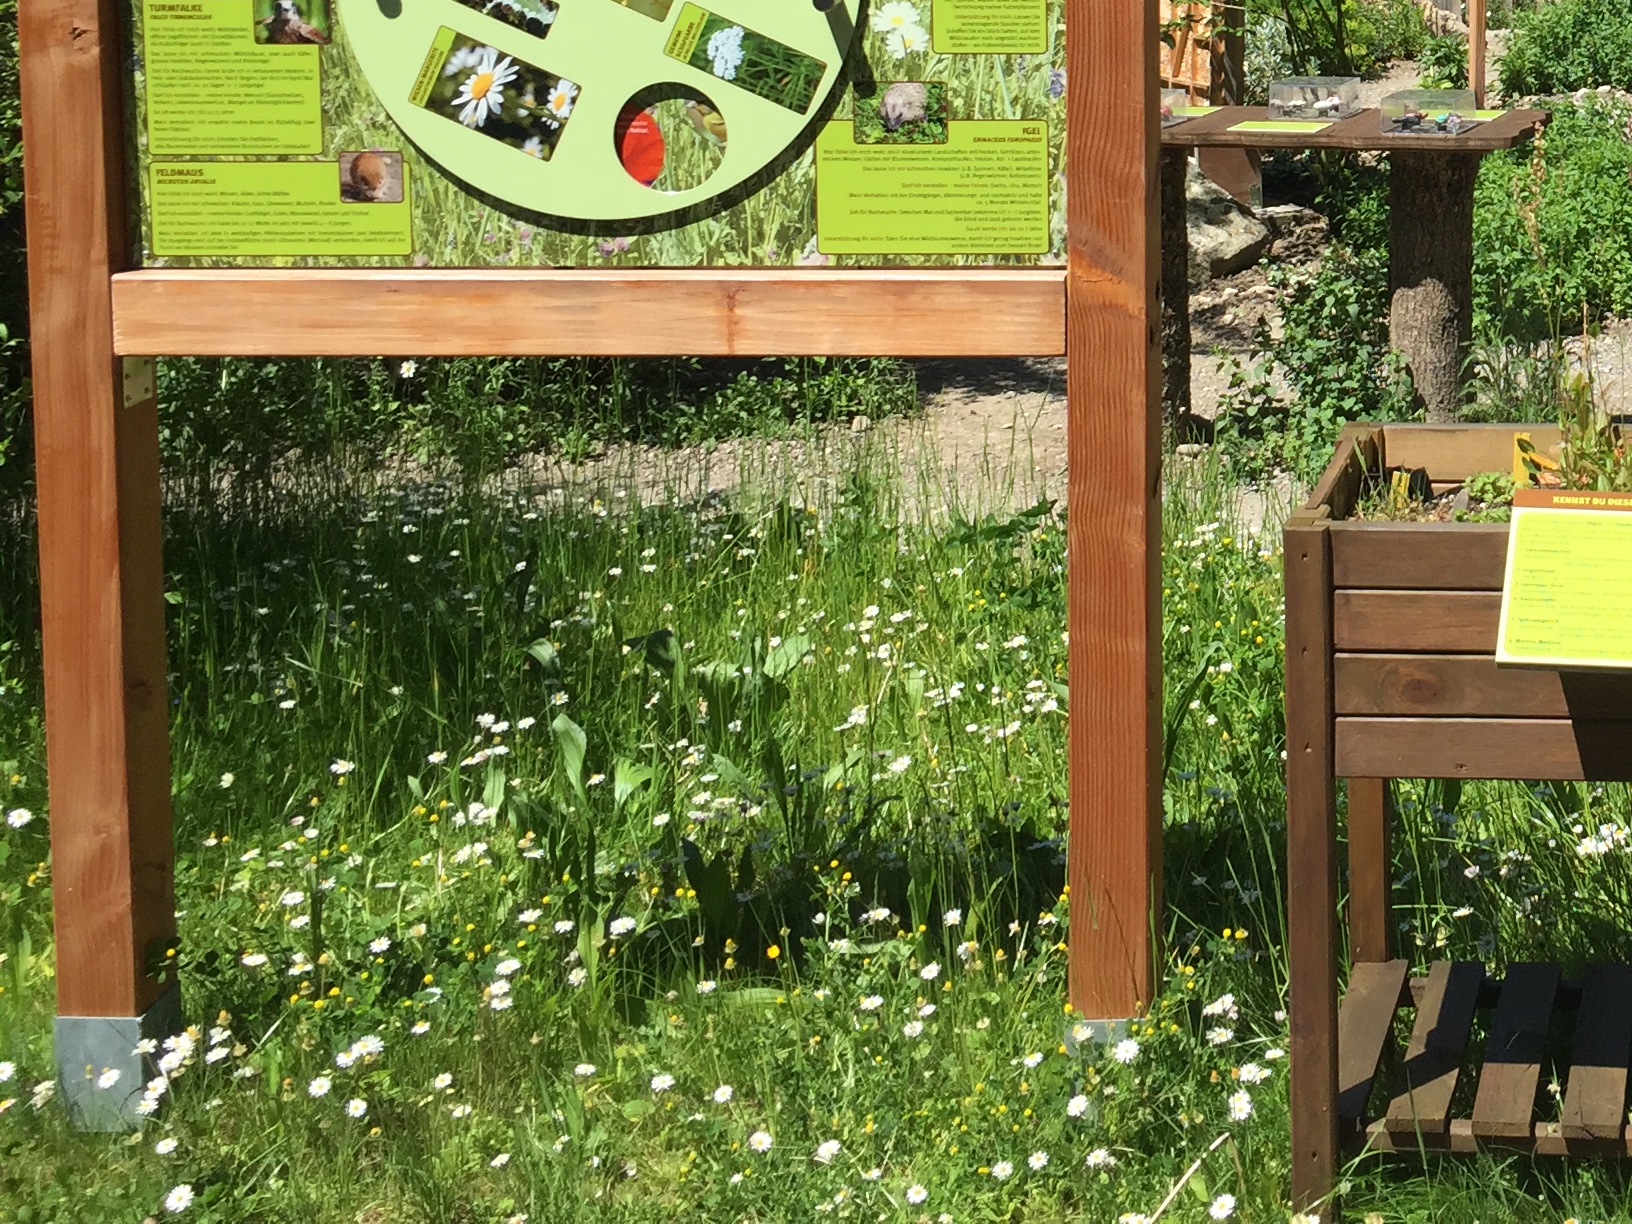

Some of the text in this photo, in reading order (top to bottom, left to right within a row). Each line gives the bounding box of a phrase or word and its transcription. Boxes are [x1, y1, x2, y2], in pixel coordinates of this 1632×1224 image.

[149, 4, 203, 13] TURMFALKE
[155, 168, 204, 177] FELDMAUS
[1552, 495, 1590, 505] KENNST
[1592, 496, 1606, 506] DU
